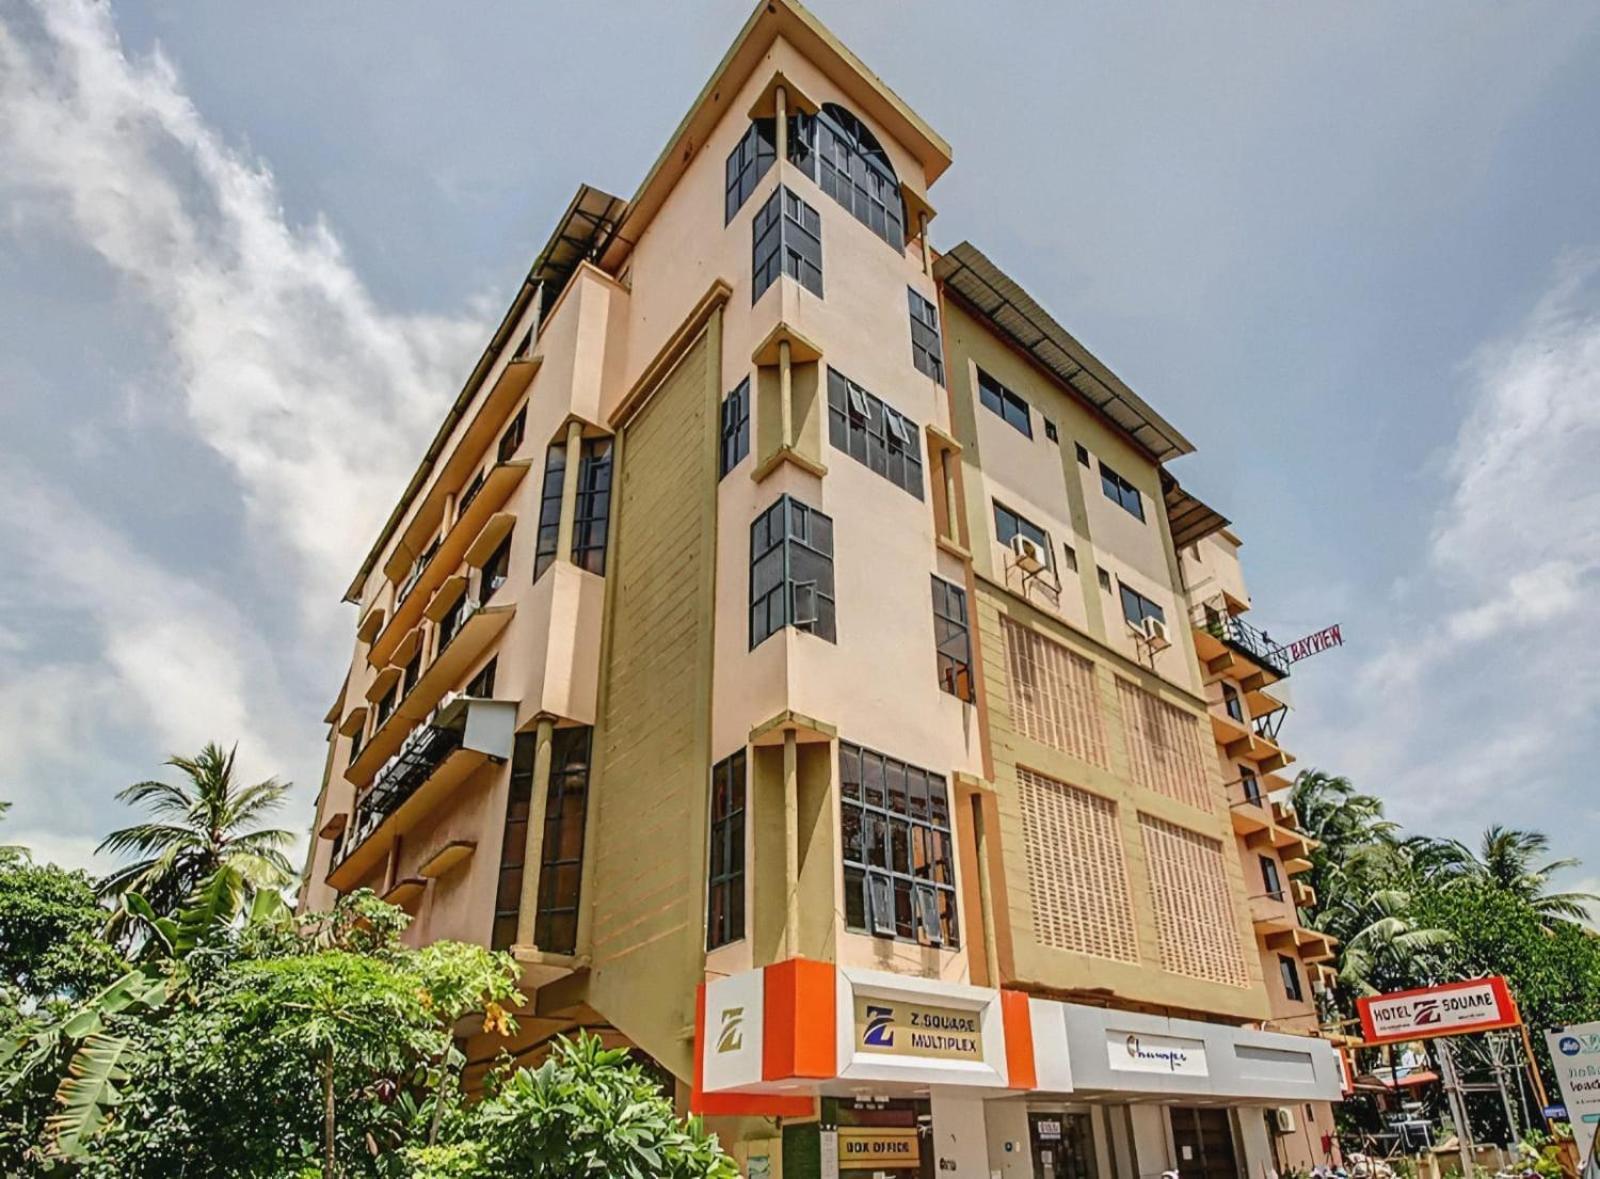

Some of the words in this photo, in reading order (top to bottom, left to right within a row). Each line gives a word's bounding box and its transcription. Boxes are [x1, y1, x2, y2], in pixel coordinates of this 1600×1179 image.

[1290, 624, 1342, 661] BAYVIEW
[1373, 1005, 1411, 1022] HOTEL
[1442, 992, 1493, 1012] SQUARE
[911, 1033, 979, 1053] MULTIPLEX
[873, 1142, 909, 1153] OFFICE
